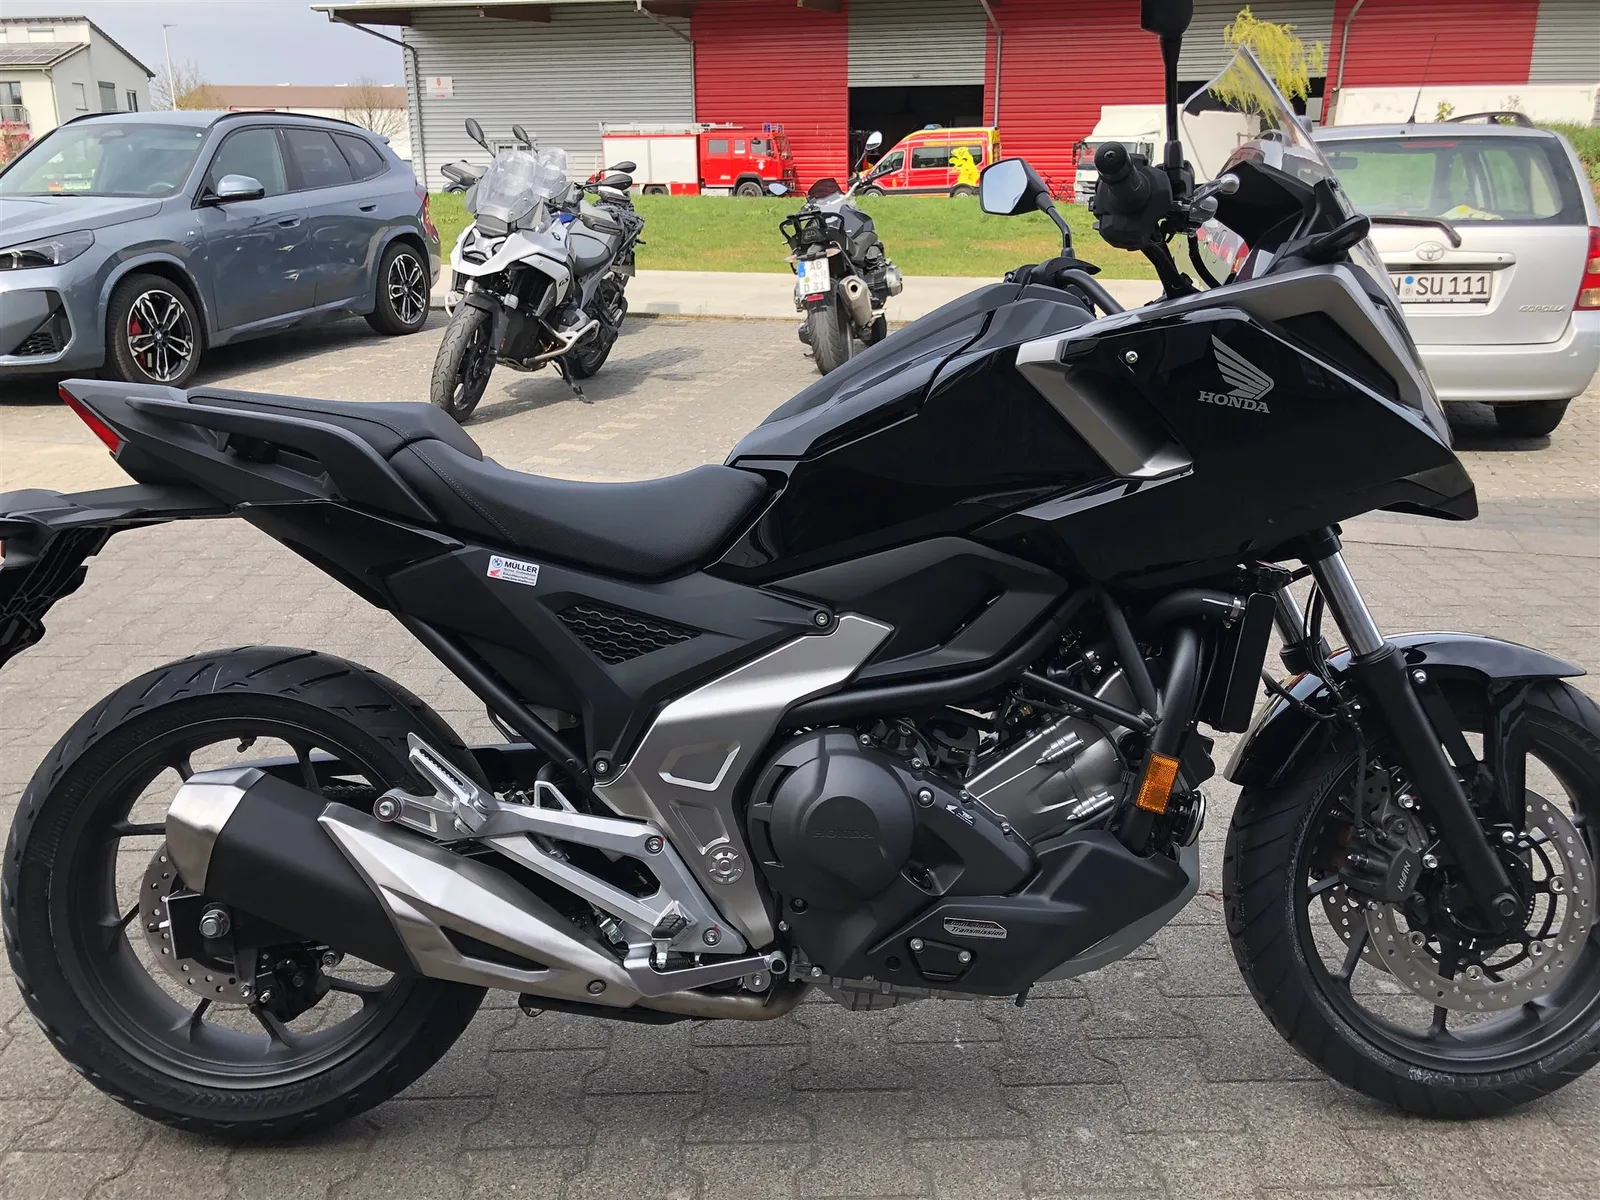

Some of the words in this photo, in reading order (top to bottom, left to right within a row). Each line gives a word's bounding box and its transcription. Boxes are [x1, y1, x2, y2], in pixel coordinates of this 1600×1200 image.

[1415, 276, 1444, 296] SU
[1447, 276, 1488, 296] 111
[1197, 390, 1271, 414] HONDA
[504, 560, 538, 574] MÜLLER
[812, 828, 875, 840] HONDA
[951, 927, 1005, 937] Transmission
